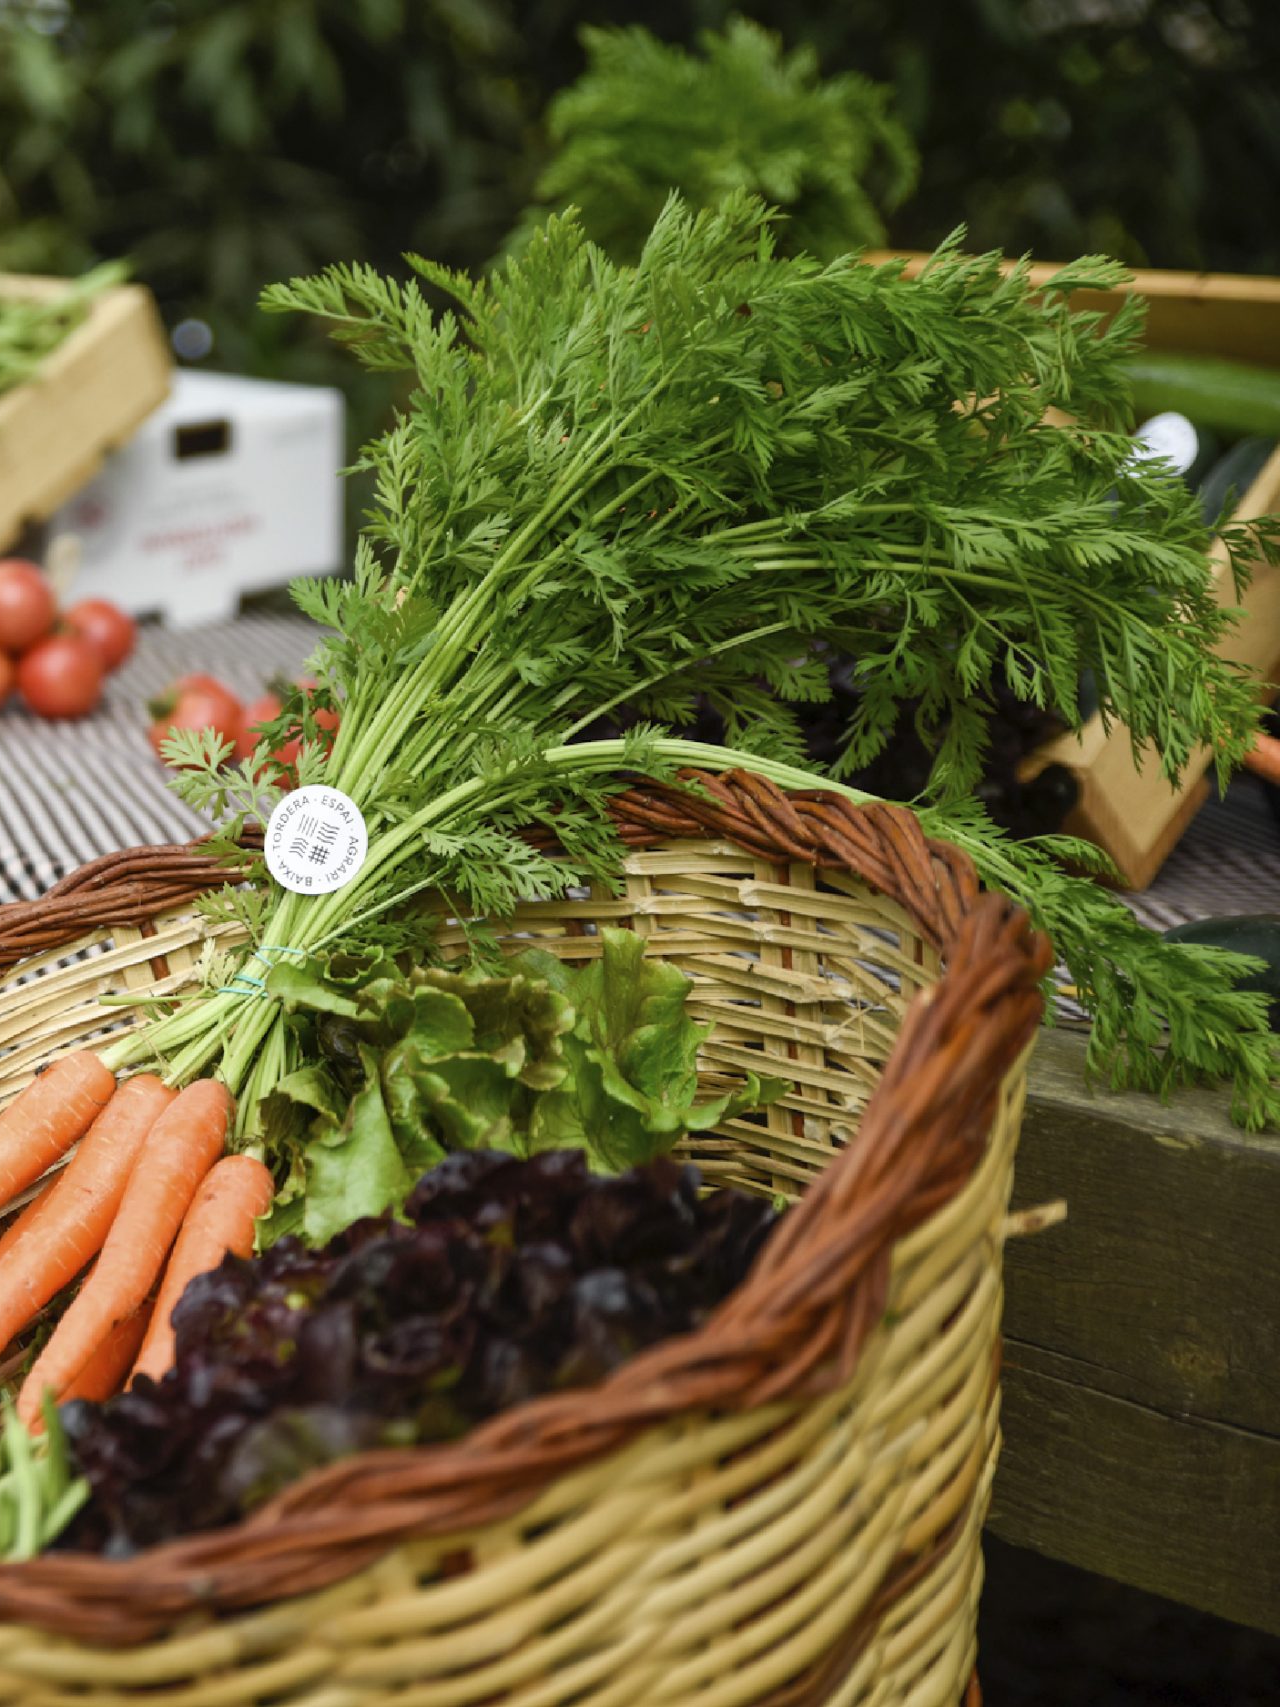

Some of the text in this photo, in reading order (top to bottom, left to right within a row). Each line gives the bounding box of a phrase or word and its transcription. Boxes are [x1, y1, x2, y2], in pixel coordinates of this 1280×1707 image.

[272, 795, 360, 887] ESPAI AGRARI BAIXA TORDERA
